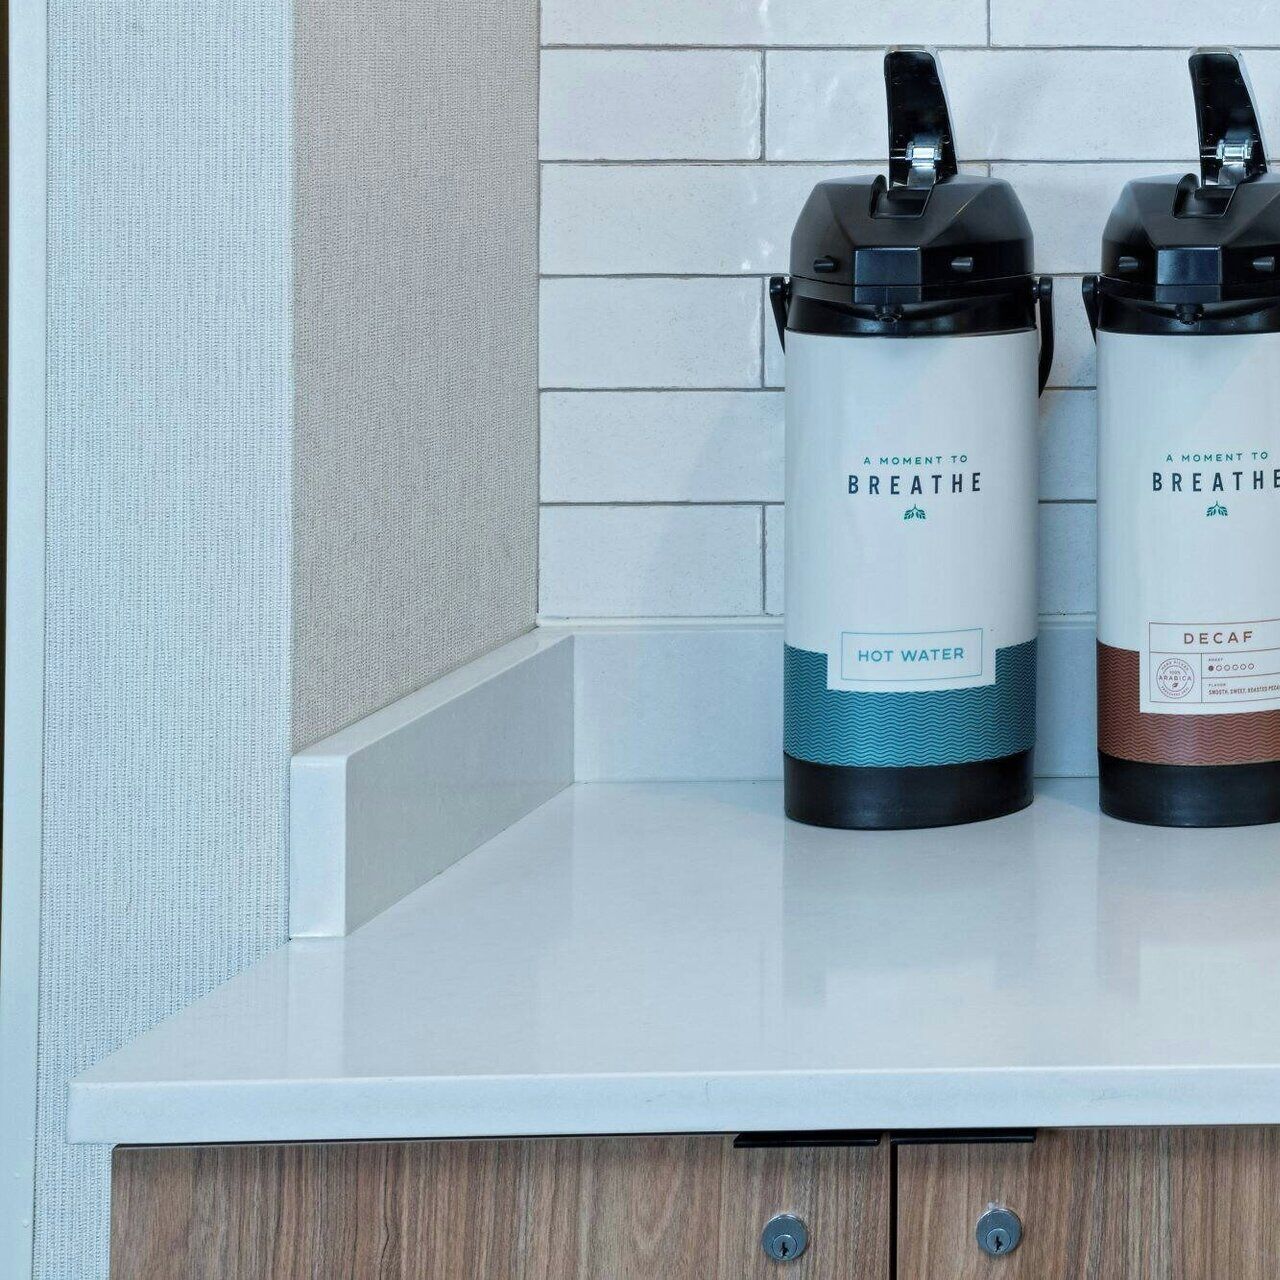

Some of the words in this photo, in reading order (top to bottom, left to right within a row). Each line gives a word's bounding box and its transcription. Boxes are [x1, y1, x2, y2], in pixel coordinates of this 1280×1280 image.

[863, 456, 871, 465] A
[880, 456, 942, 465] MOMENT
[950, 455, 968, 463] TO
[1166, 454, 1174, 462] A
[1181, 453, 1243, 462] MOMENT
[1251, 451, 1268, 460] TO
[848, 472, 981, 495] BREATHE
[1184, 631, 1253, 645] DECAF
[858, 650, 894, 662] HOT
[901, 647, 964, 662] WATER
